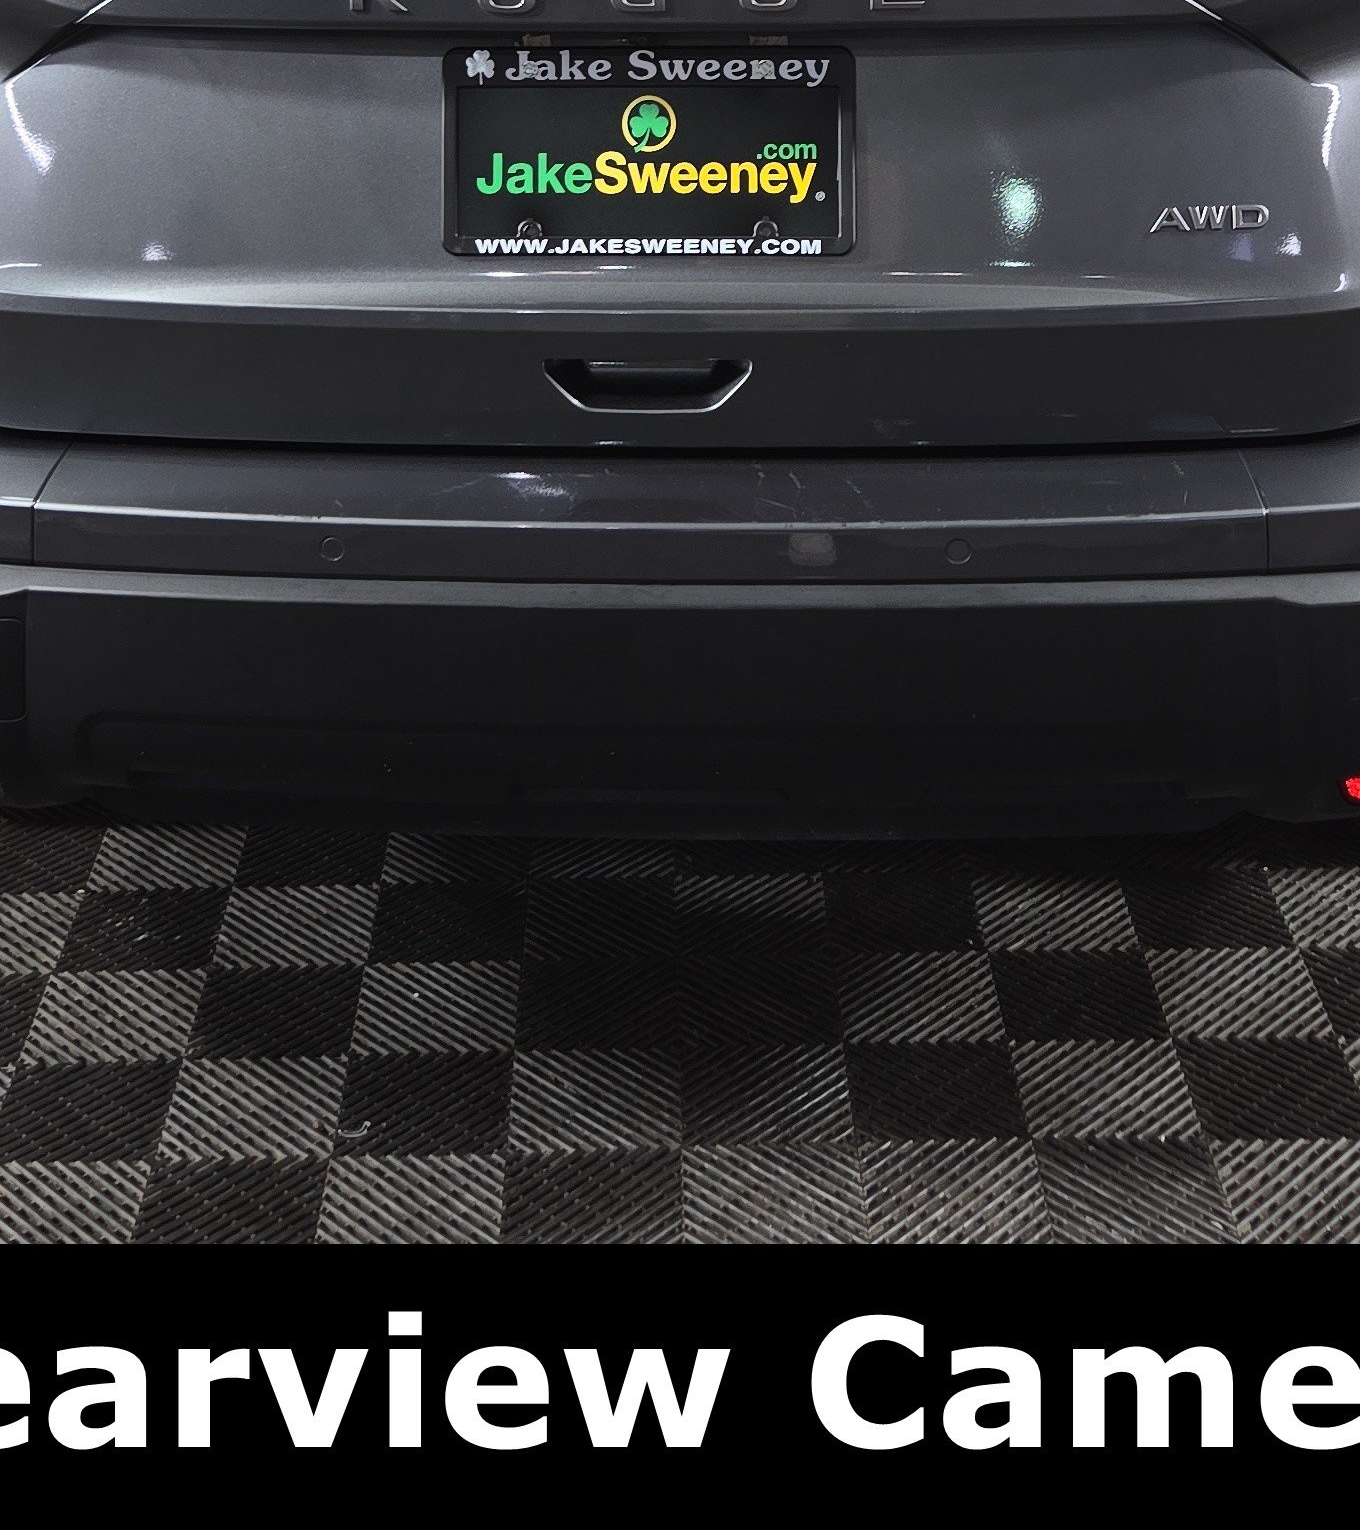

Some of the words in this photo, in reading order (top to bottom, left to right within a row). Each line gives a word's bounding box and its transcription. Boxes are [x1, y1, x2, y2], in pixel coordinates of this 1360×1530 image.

[505, 50, 612, 81] Jake
[628, 50, 830, 87] Sweeney
[1149, 204, 1270, 233] AWD
[475, 238, 822, 255] WWW.JAKESWEENEY.COM
